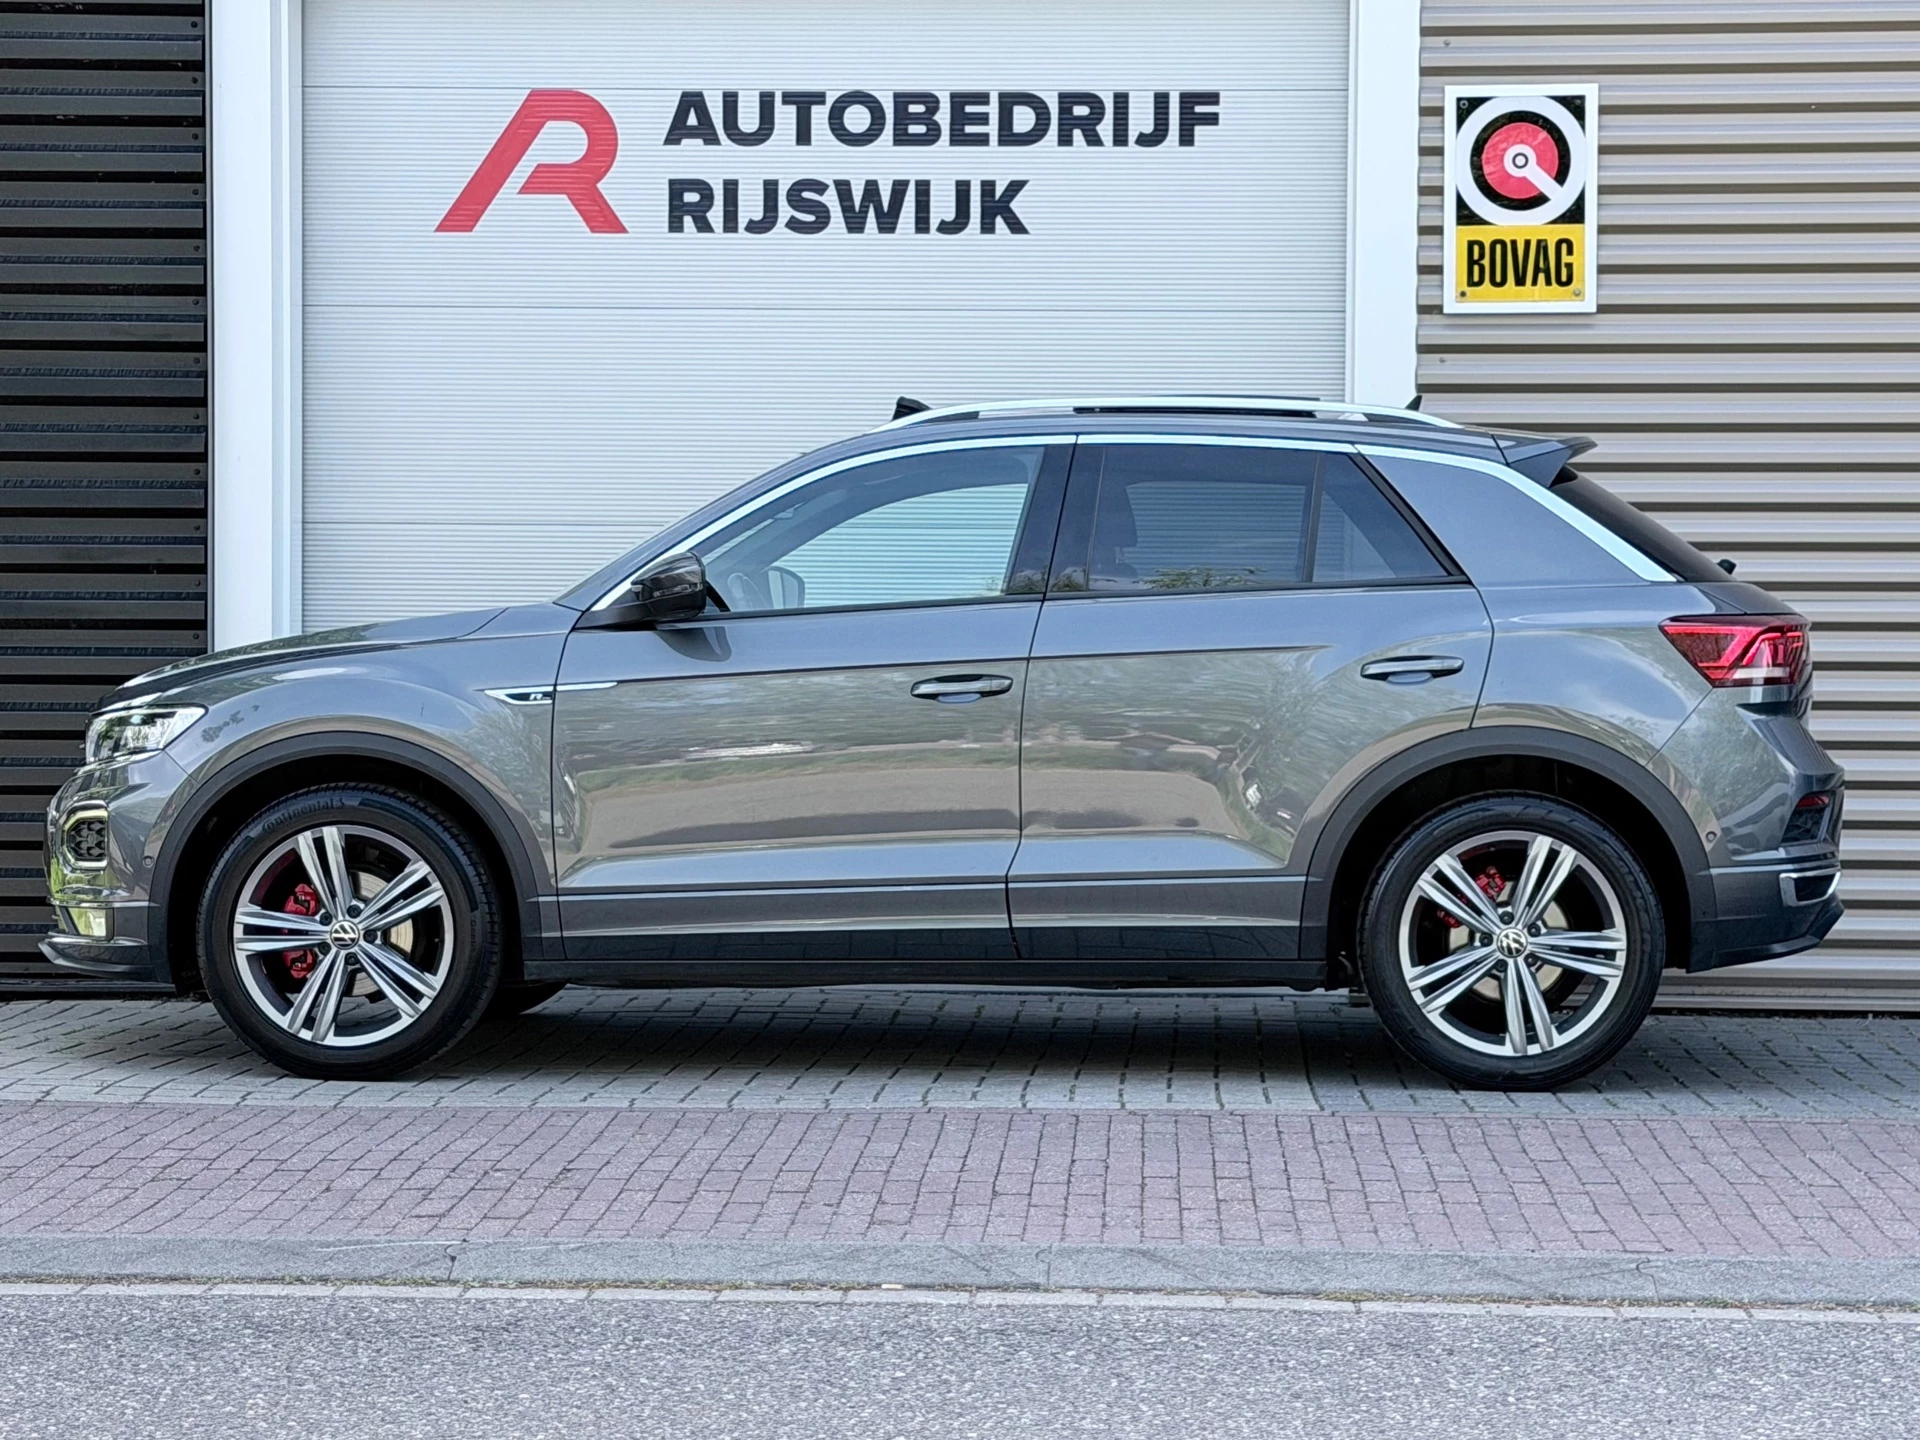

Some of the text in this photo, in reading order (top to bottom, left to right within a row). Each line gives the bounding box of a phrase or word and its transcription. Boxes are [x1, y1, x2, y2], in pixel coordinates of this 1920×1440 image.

[663, 90, 1221, 148] AUTOBEDRIJF
[667, 178, 1030, 235] RIJSWIJK
[1466, 238, 1574, 289] BOVAG
[262, 797, 334, 832] Continental
